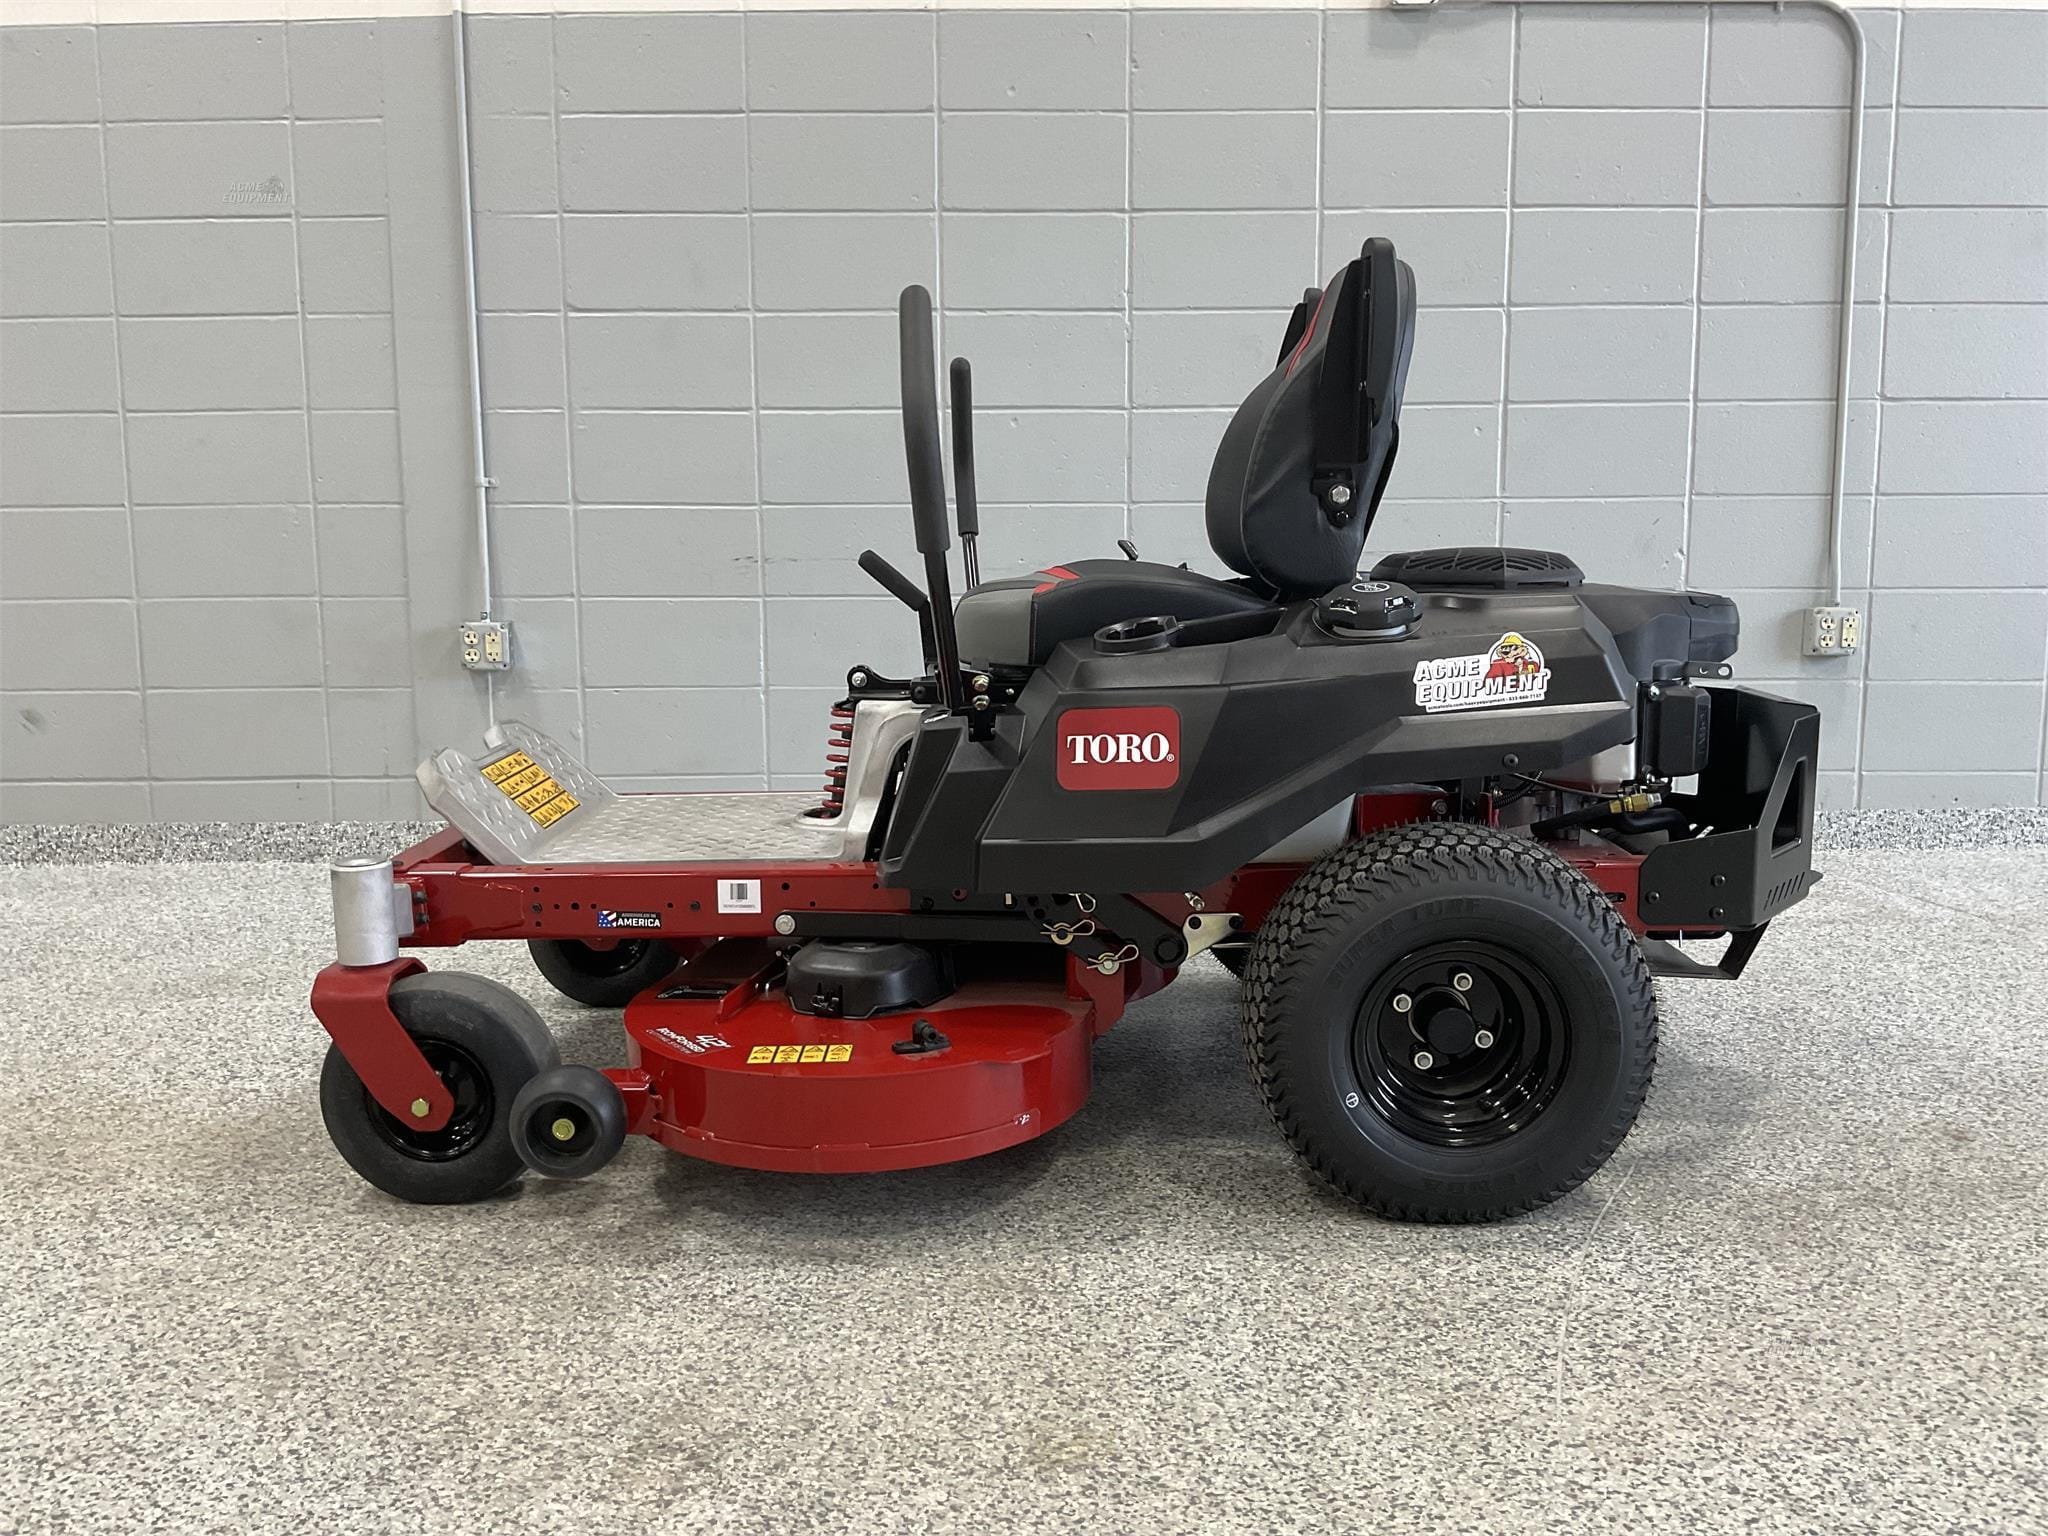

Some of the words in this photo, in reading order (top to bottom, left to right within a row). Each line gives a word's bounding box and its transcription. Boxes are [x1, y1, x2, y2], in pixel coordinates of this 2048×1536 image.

[1418, 658, 1481, 682] ACME
[1420, 672, 1547, 702] EQUIPMENT
[1066, 732, 1170, 764] TORO
[617, 918, 661, 928] AMERICA
